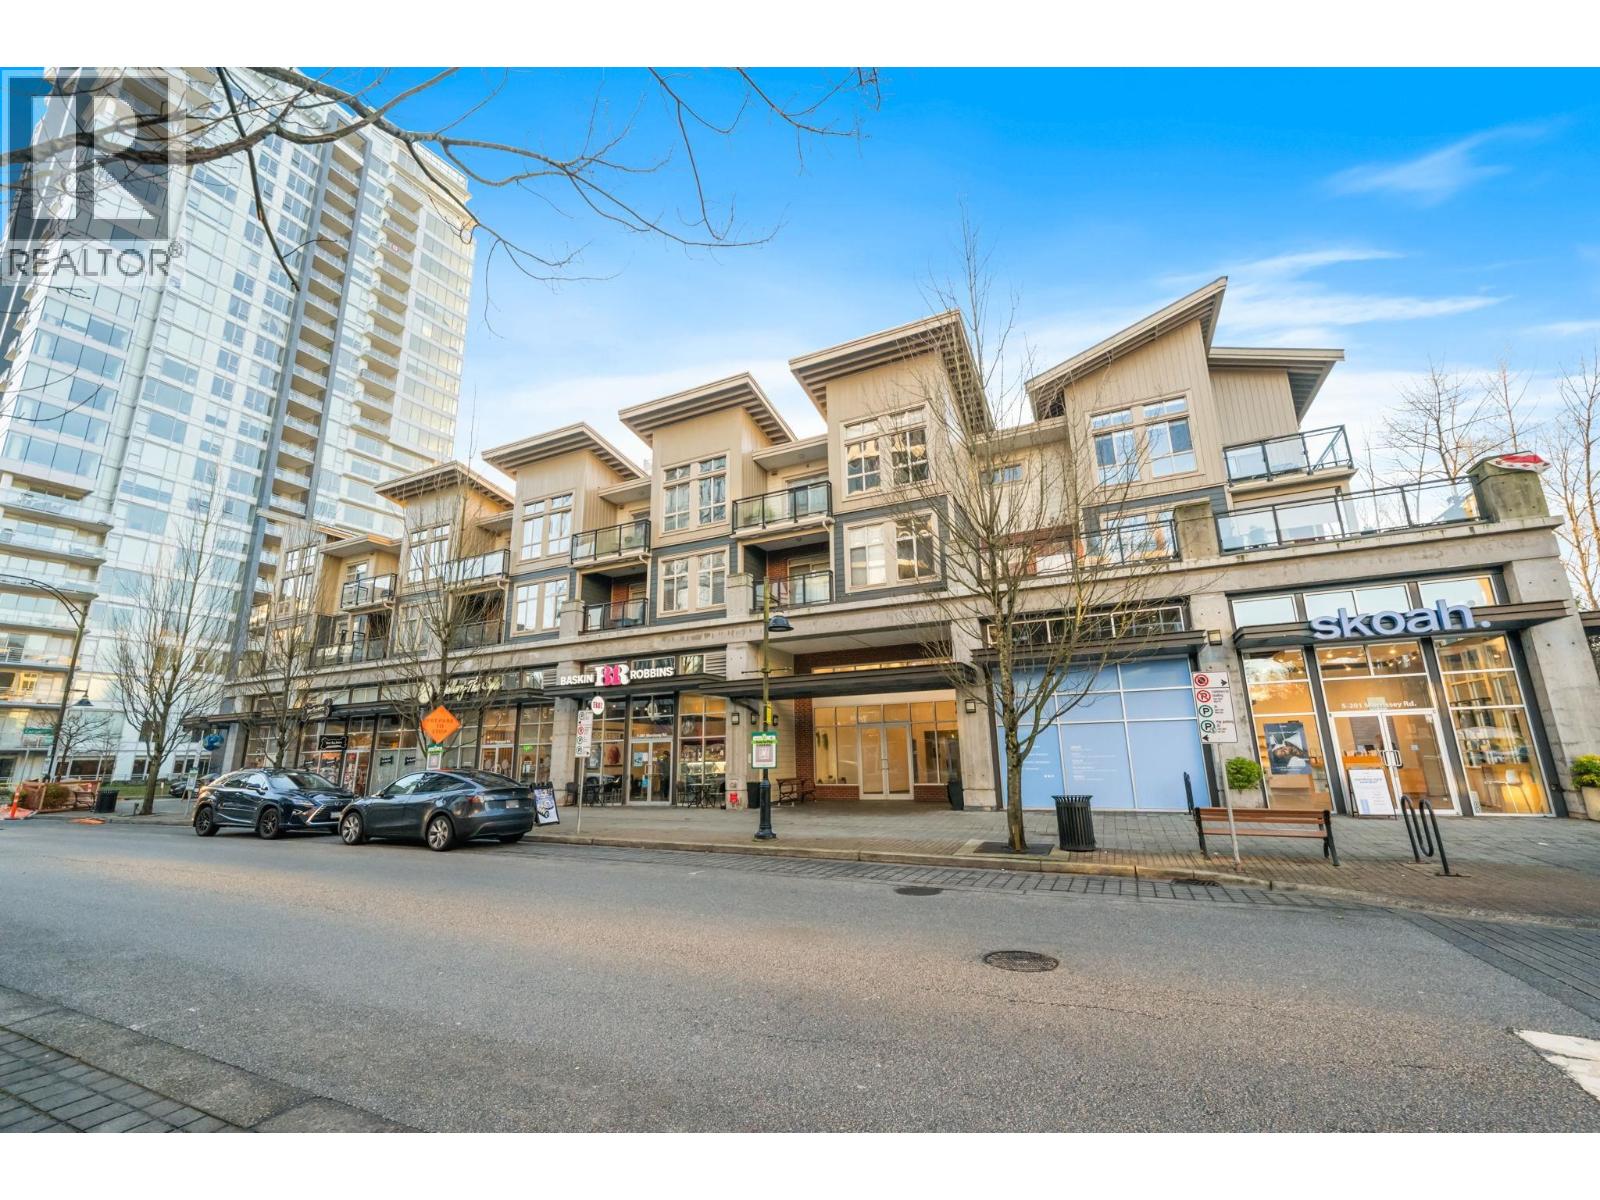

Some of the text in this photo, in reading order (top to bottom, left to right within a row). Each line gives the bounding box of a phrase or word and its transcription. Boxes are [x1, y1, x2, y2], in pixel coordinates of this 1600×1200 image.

[560, 674, 595, 687] BASKIN
[630, 666, 675, 680] ROBBINS
[1402, 699, 1417, 708] Rd.
